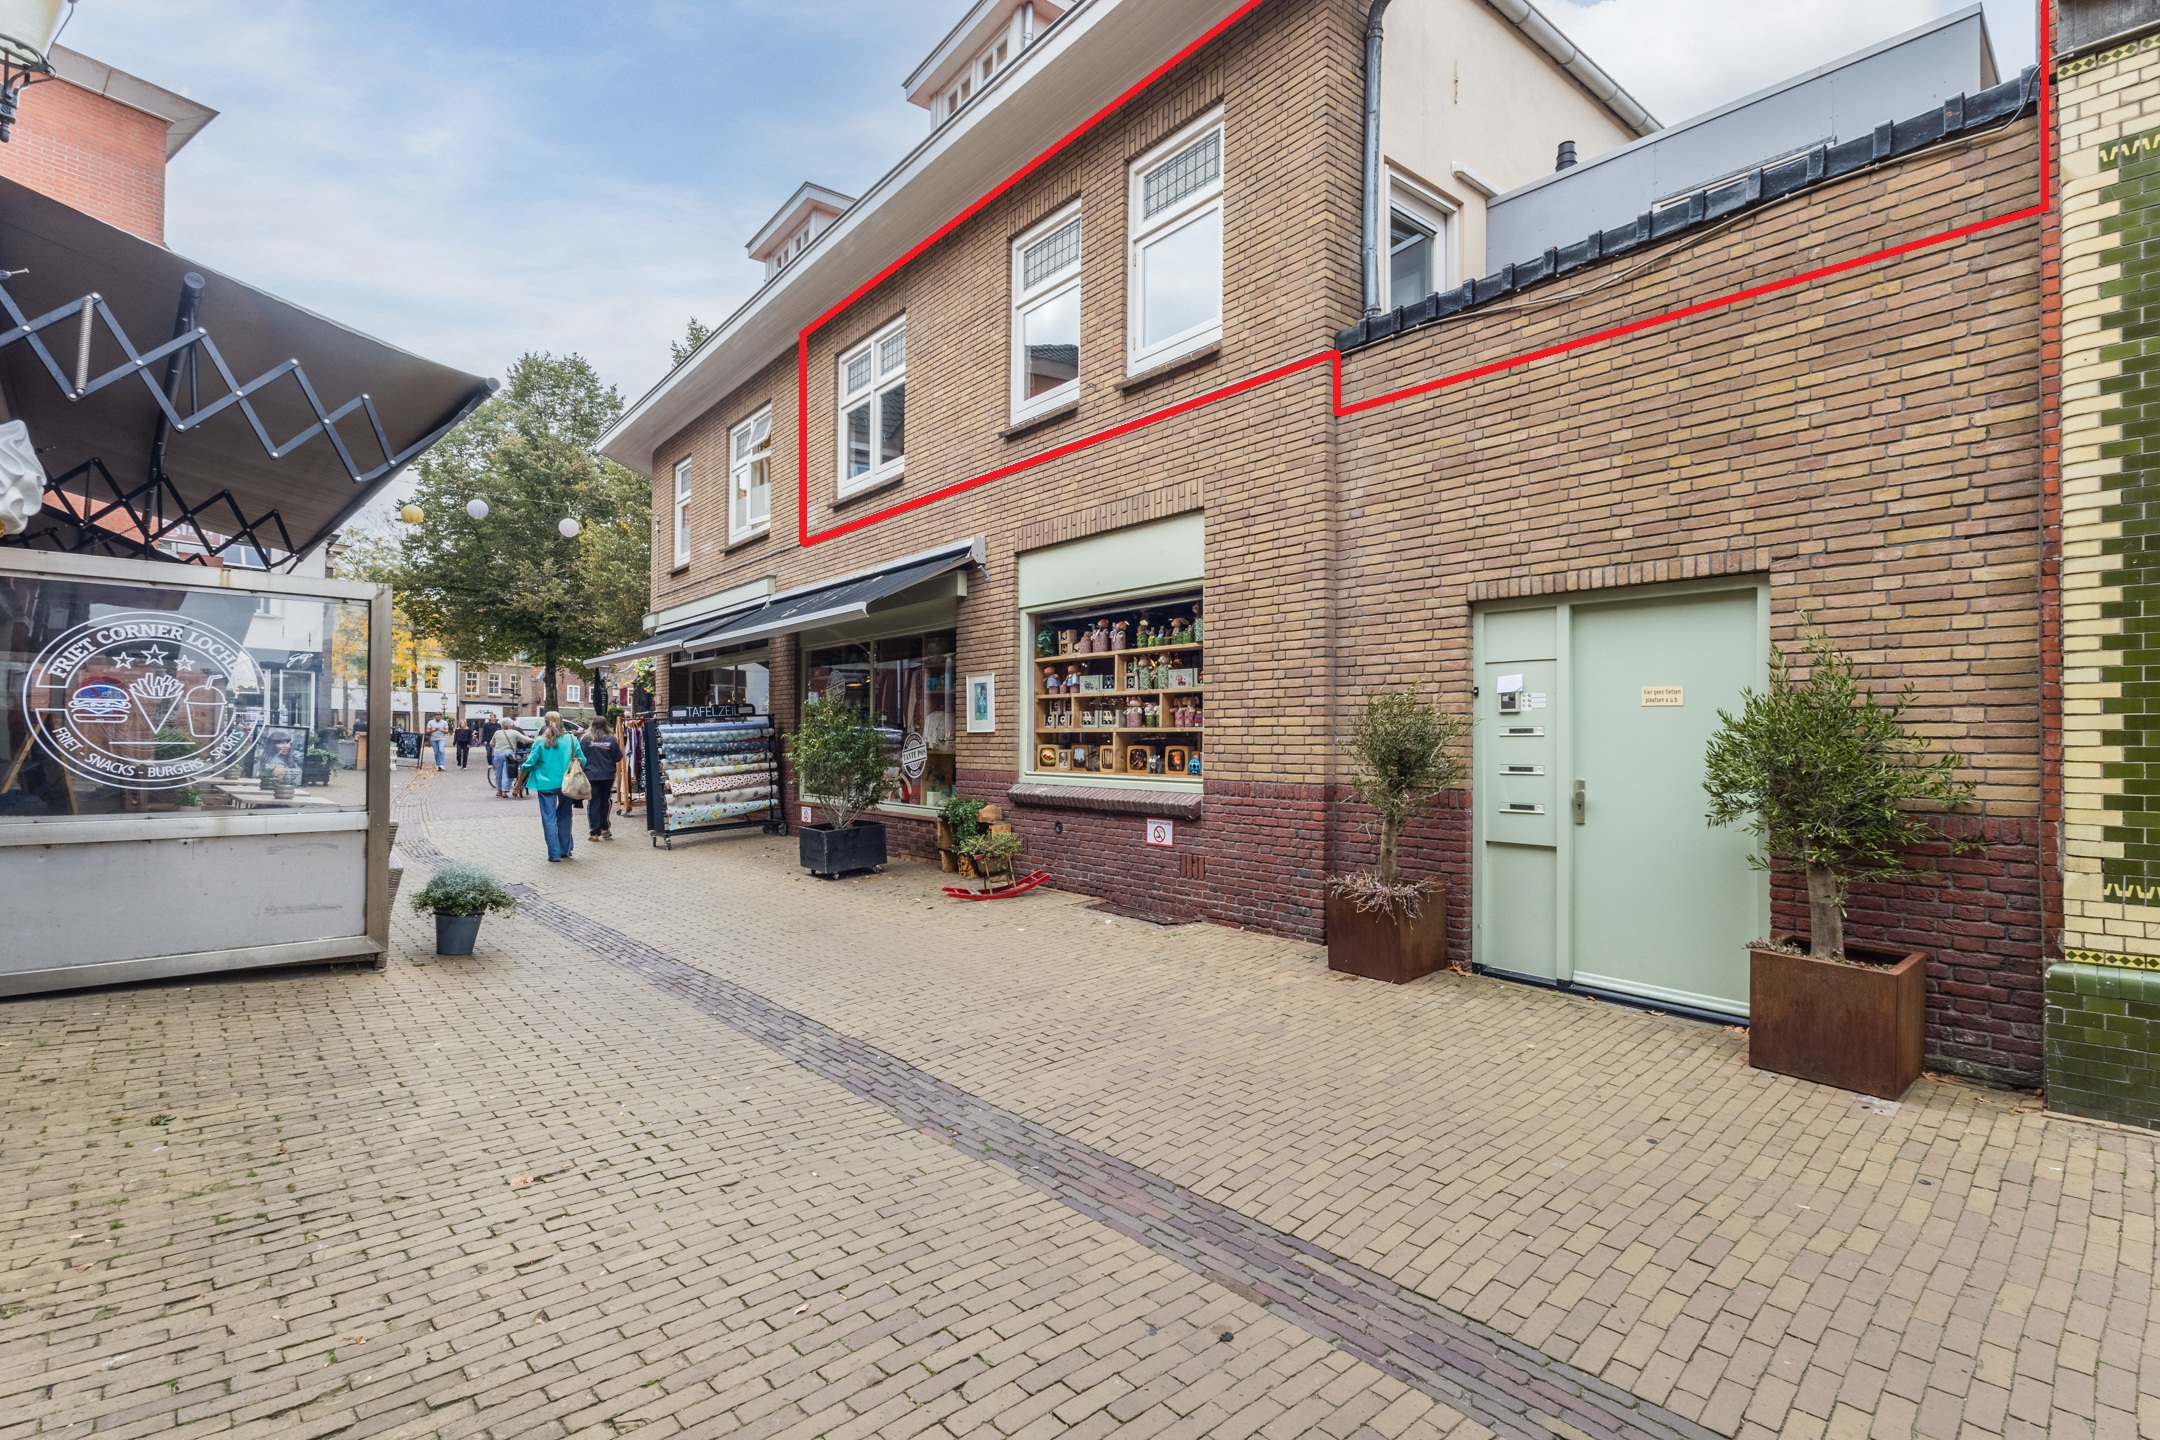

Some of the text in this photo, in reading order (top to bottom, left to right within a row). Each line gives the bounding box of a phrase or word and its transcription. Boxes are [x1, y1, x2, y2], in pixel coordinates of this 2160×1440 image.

[48, 624, 245, 679] FRIET CORNER LOCH
[686, 705, 741, 718] TAFELZEIL
[52, 726, 83, 751] FRIET
[84, 752, 136, 776] SNACKS
[147, 757, 205, 778] BURGERS
[209, 728, 245, 760] SPORTS
